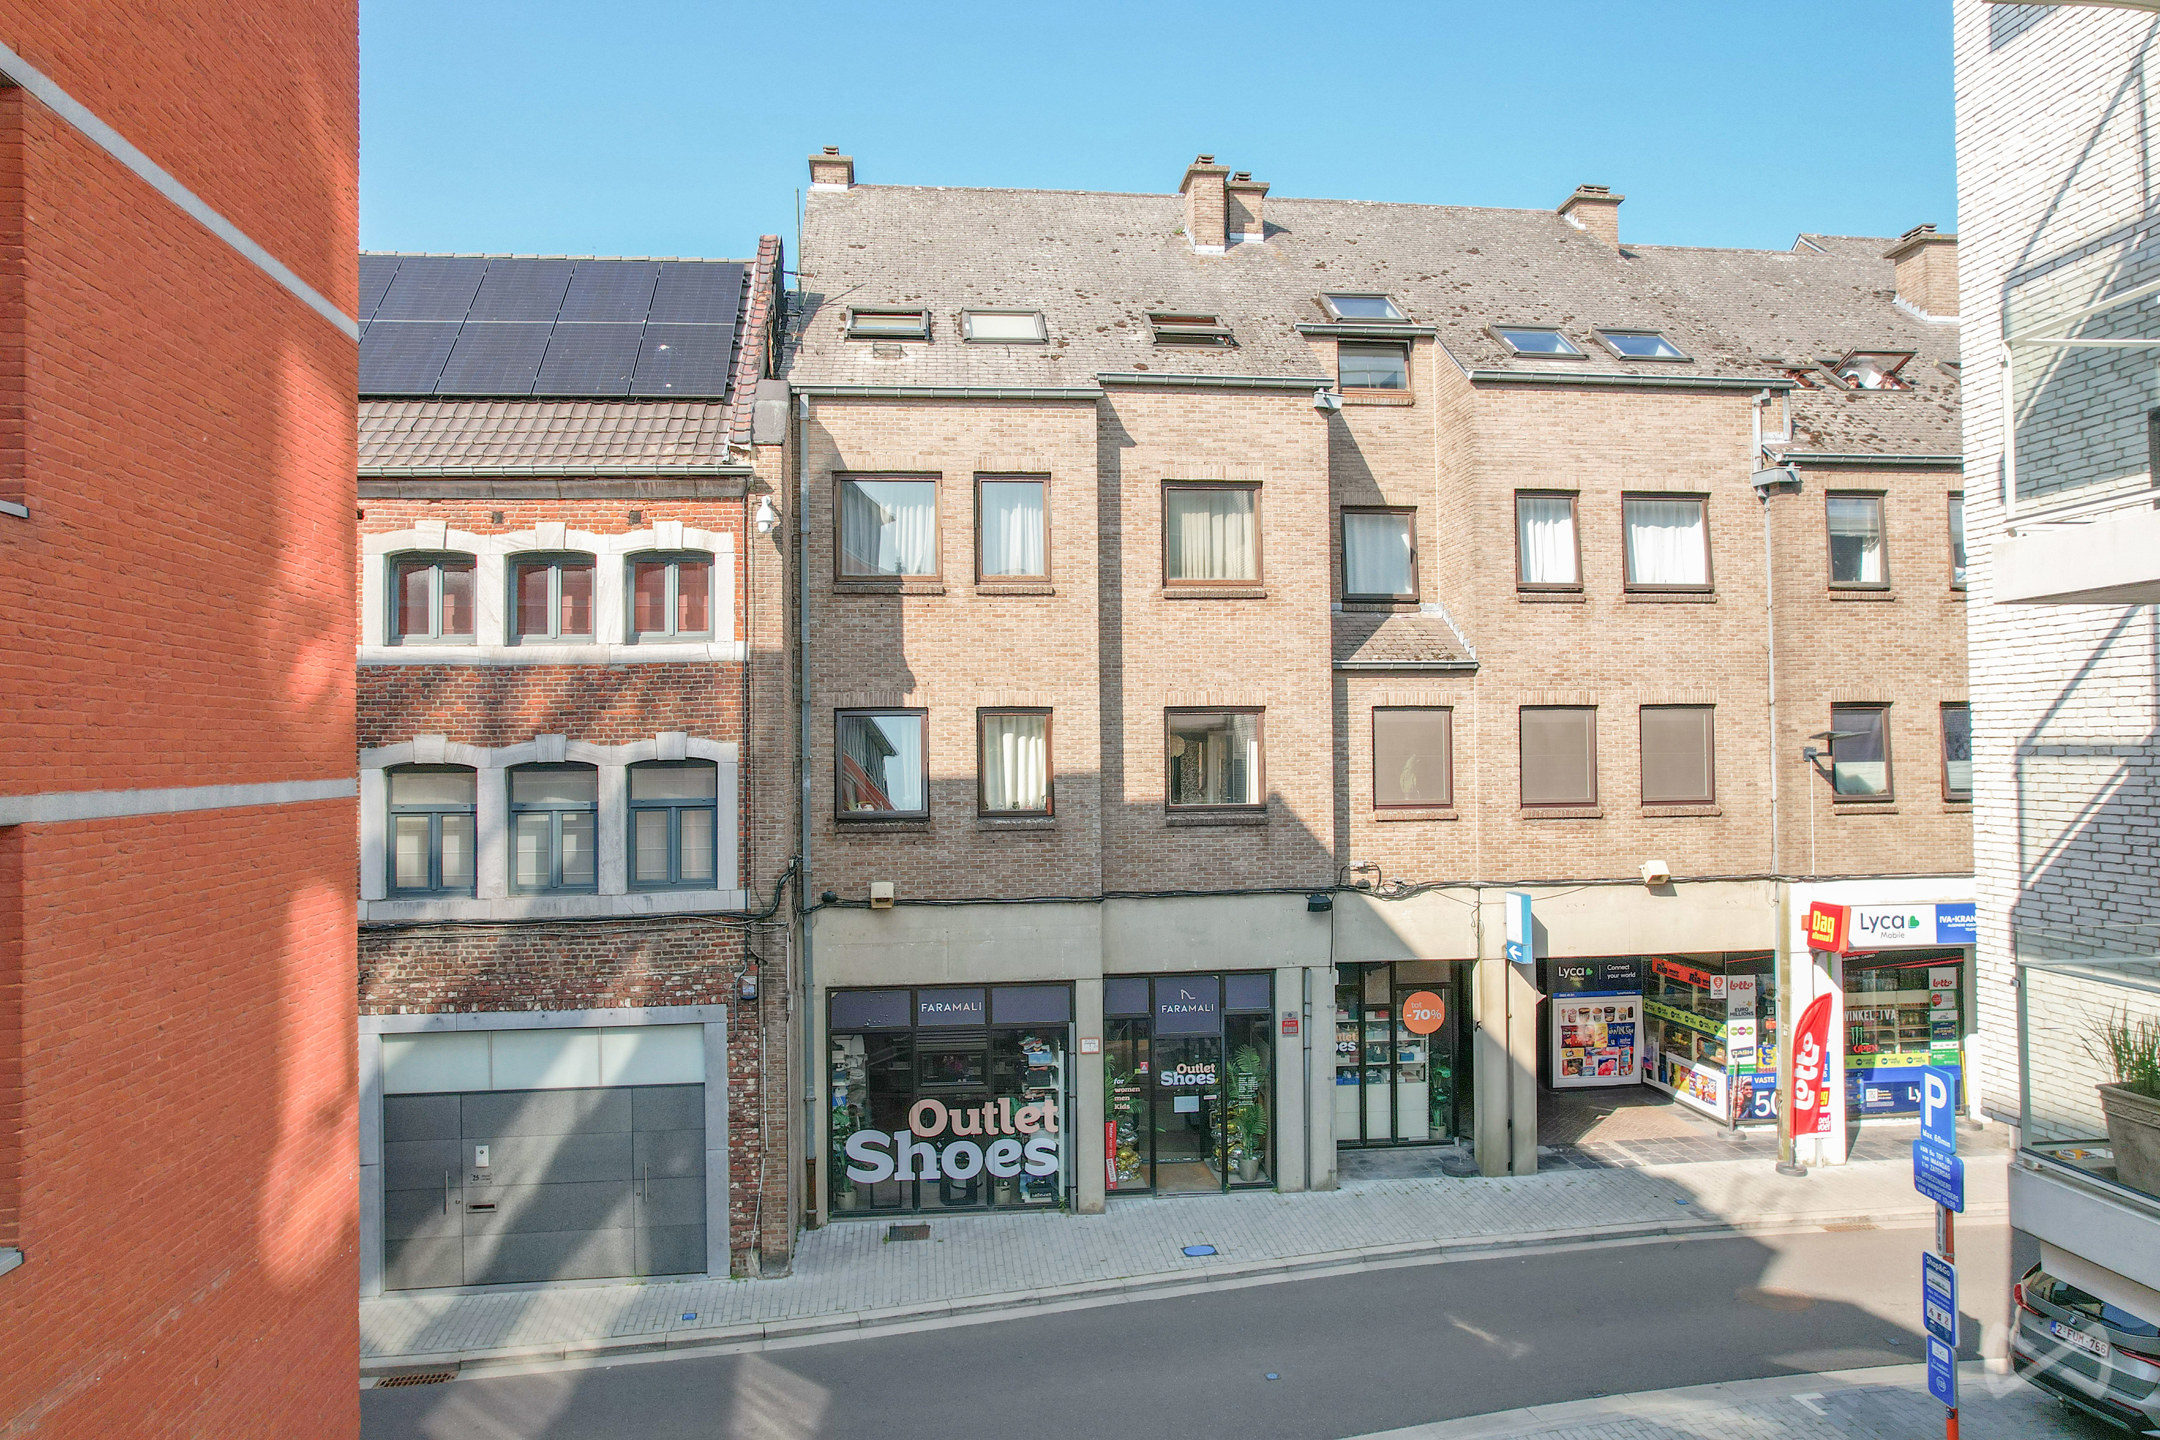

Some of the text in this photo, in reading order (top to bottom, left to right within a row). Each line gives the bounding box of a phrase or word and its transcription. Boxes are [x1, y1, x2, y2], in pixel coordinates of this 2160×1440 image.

[1812, 910, 1835, 942] Dag
[1860, 912, 1905, 933] Lyca
[1880, 931, 1905, 939] Mobile
[1558, 966, 1585, 978] Lyca
[1688, 971, 1701, 984] Ria
[921, 1002, 982, 1013] FARAMALI
[1161, 1003, 1214, 1013] FARAMALI
[1411, 1001, 1422, 1009] tot
[1406, 1008, 1442, 1020] -70%
[1732, 1049, 1753, 1057] CASH
[1853, 1044, 1879, 1054] OPEN
[1176, 1063, 1216, 1074] Outlet
[1160, 1071, 1216, 1086] Shoes
[1754, 1076, 1775, 1084] VASTE
[1908, 1086, 1921, 1103] Ly
[1925, 1072, 1947, 1128] P
[908, 1097, 1059, 1138] Outlet
[1934, 1133, 1951, 1148] 60min
[845, 1129, 1059, 1184] Shoes
[1936, 1150, 1945, 1161] TOT
[1930, 1156, 1951, 1172] MAANDAG
[1929, 1163, 1951, 1180] ZATERDAG
[1926, 1255, 1951, 1277] Shop&Go
